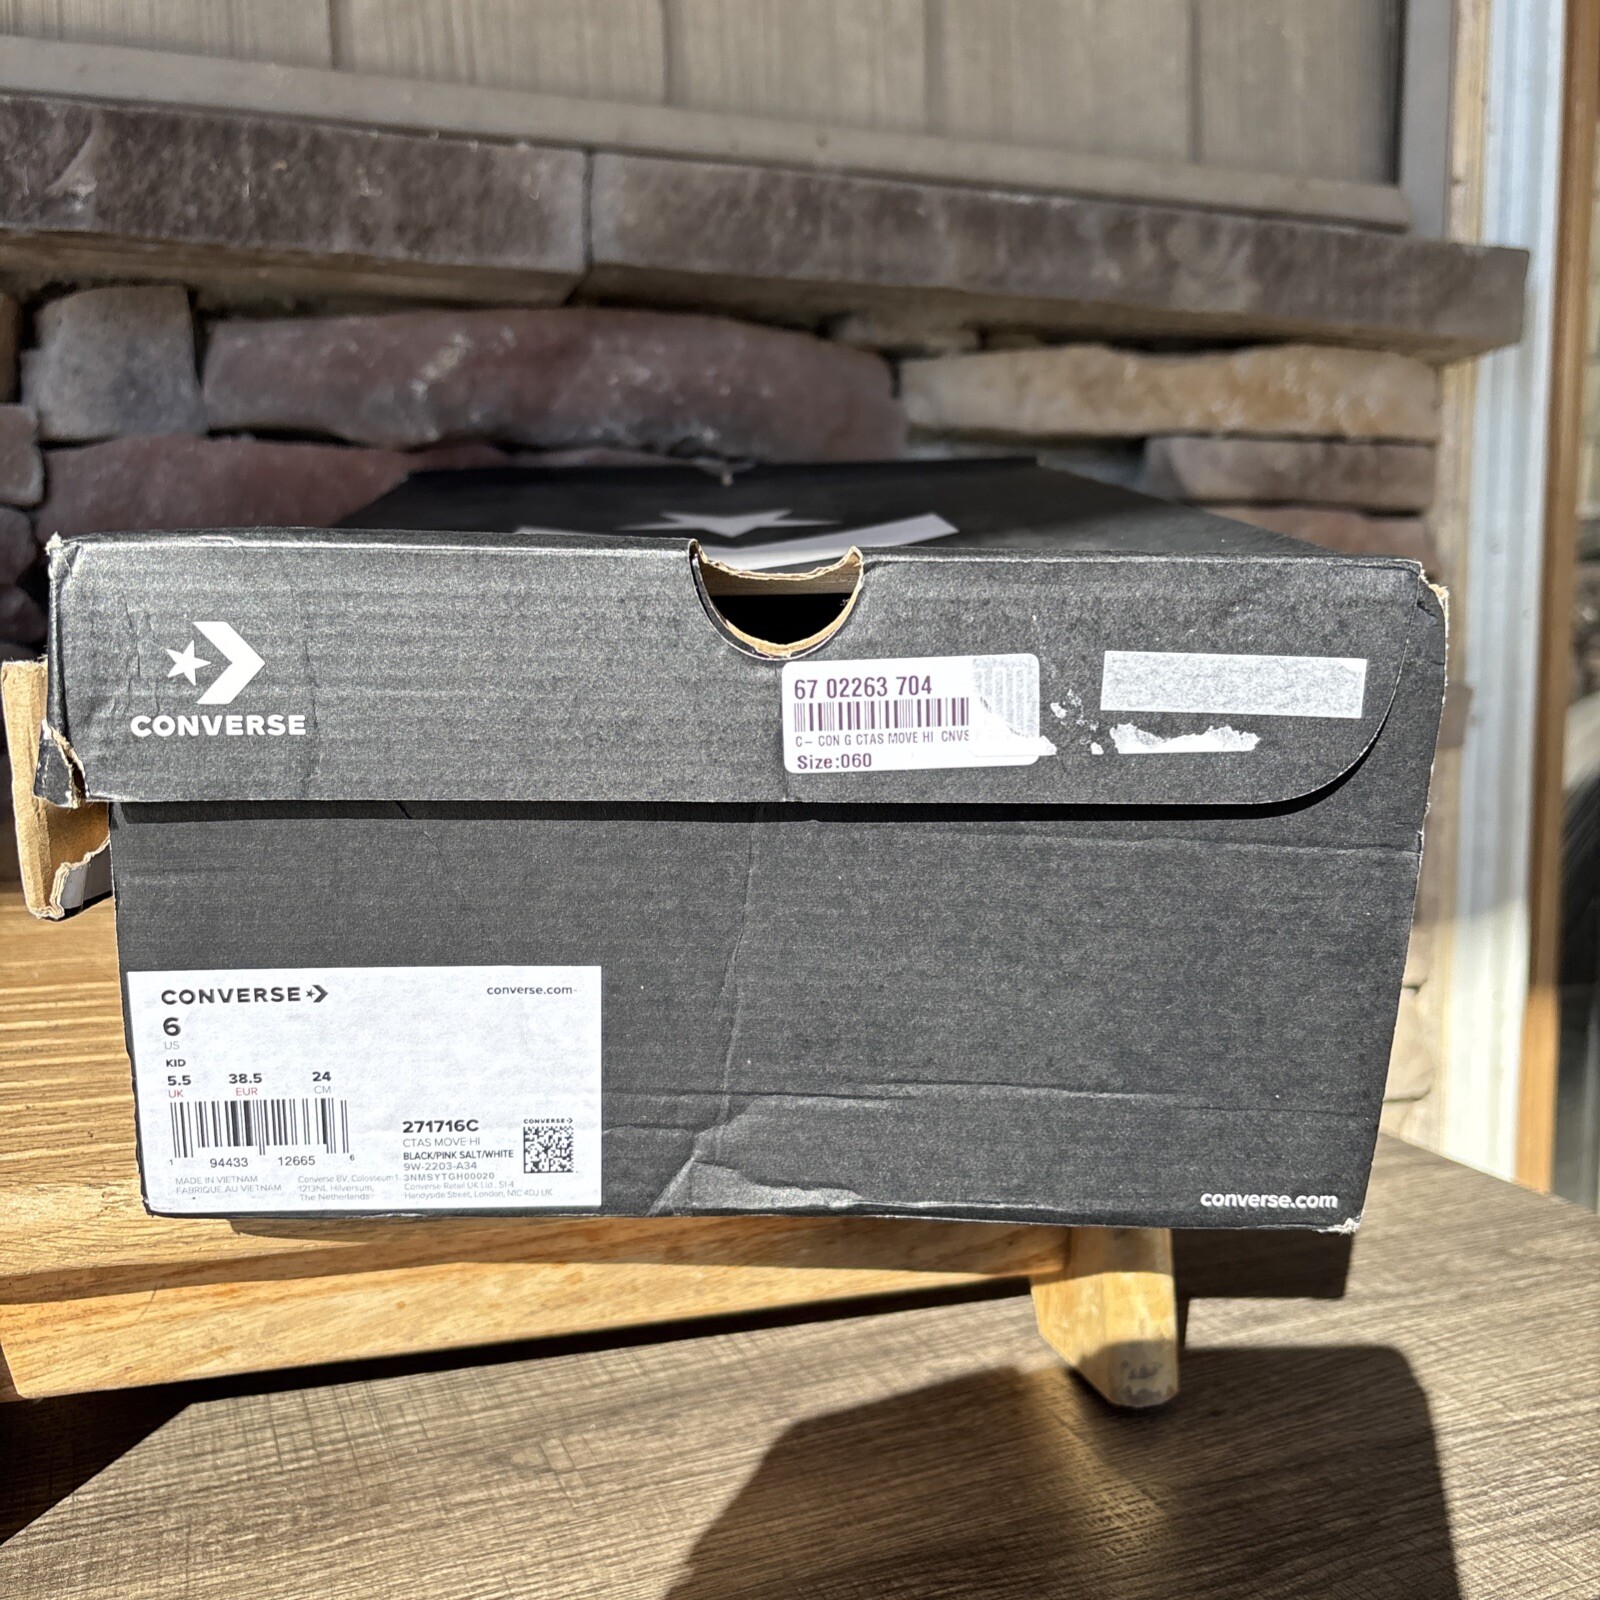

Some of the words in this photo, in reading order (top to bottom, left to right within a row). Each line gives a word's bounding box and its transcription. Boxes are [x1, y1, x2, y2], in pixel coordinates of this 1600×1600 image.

[793, 679, 818, 700] 67
[826, 676, 888, 698] 02263
[896, 675, 932, 696] 704
[130, 714, 307, 737] CONVERSE
[818, 734, 840, 746] CON
[844, 734, 852, 745] G
[856, 733, 884, 745] CTAS
[888, 731, 918, 744] MOVE
[923, 730, 934, 743] HI
[941, 729, 969, 742] CNVS
[797, 753, 872, 770] Size:060
[161, 986, 301, 1005] CONVERSE
[486, 986, 573, 995] converse.com
[163, 1017, 181, 1036] 6
[164, 1041, 180, 1050] US
[165, 1059, 186, 1068] KID
[167, 1075, 192, 1086] 5.5
[228, 1073, 263, 1084] 38.5
[312, 1071, 332, 1082] 24
[168, 1089, 184, 1098] UK
[235, 1087, 258, 1096] EUR
[314, 1085, 331, 1094] CM
[402, 1119, 480, 1133] 271716C
[402, 1138, 432, 1147] CTAS
[434, 1137, 467, 1146] MOVE
[469, 1137, 480, 1146] HI
[403, 1151, 458, 1160] BLACK/PINK
[459, 1150, 514, 1159] SALT/WHITE
[209, 1157, 249, 1168] 94433
[277, 1156, 316, 1167] 12665
[403, 1162, 478, 1171] 9W-2203-A34
[175, 1177, 202, 1185] MADE
[205, 1176, 214, 1184] IN
[216, 1175, 258, 1184] VIETNAM
[298, 1175, 334, 1183] Converse
[176, 1186, 222, 1194] FABRIQUE
[224, 1185, 239, 1193] AU
[240, 1184, 282, 1192] VIETNAM
[541, 1188, 553, 1196] UK
[300, 1193, 316, 1201] The
[1200, 1192, 1338, 1209] converse.com
